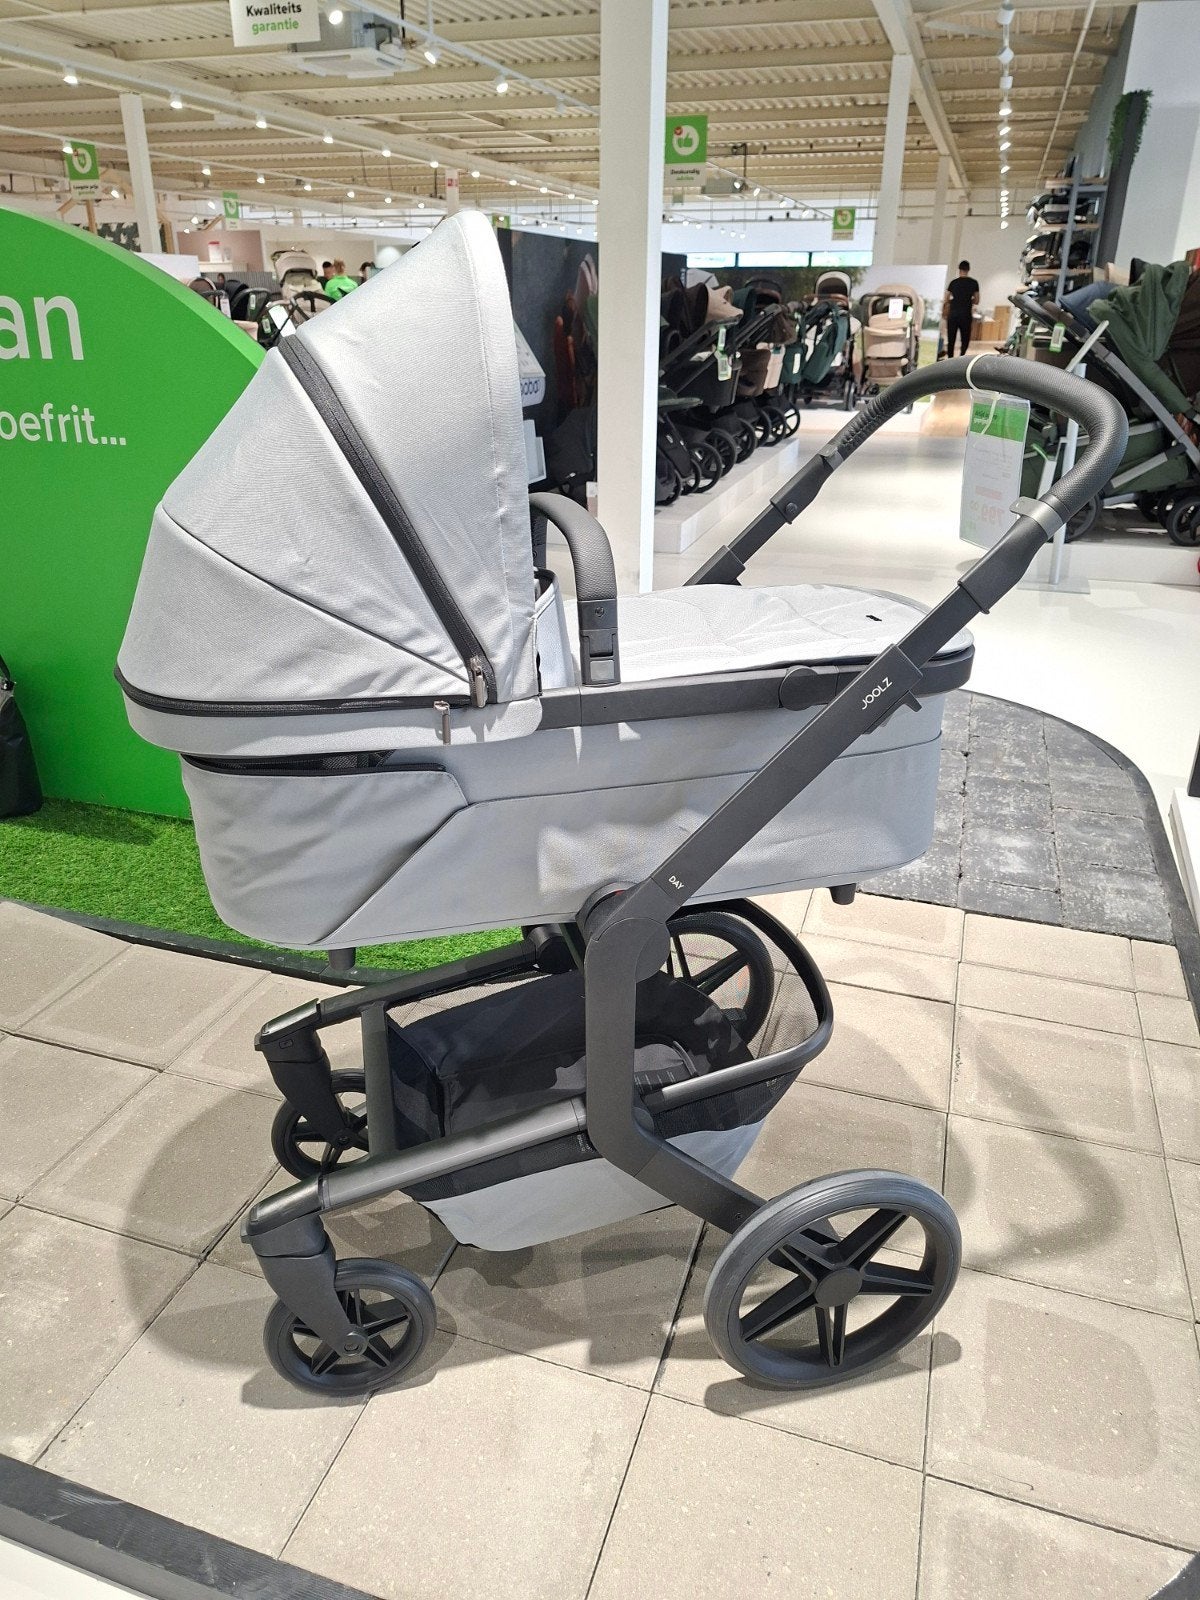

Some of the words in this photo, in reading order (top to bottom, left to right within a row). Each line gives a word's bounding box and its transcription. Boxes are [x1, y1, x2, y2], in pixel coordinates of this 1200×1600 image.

[246, 3, 302, 17] Kwaliteits
[252, 18, 299, 35] garantie
[862, 676, 893, 710] JOOLZ
[668, 875, 685, 890] DAY
